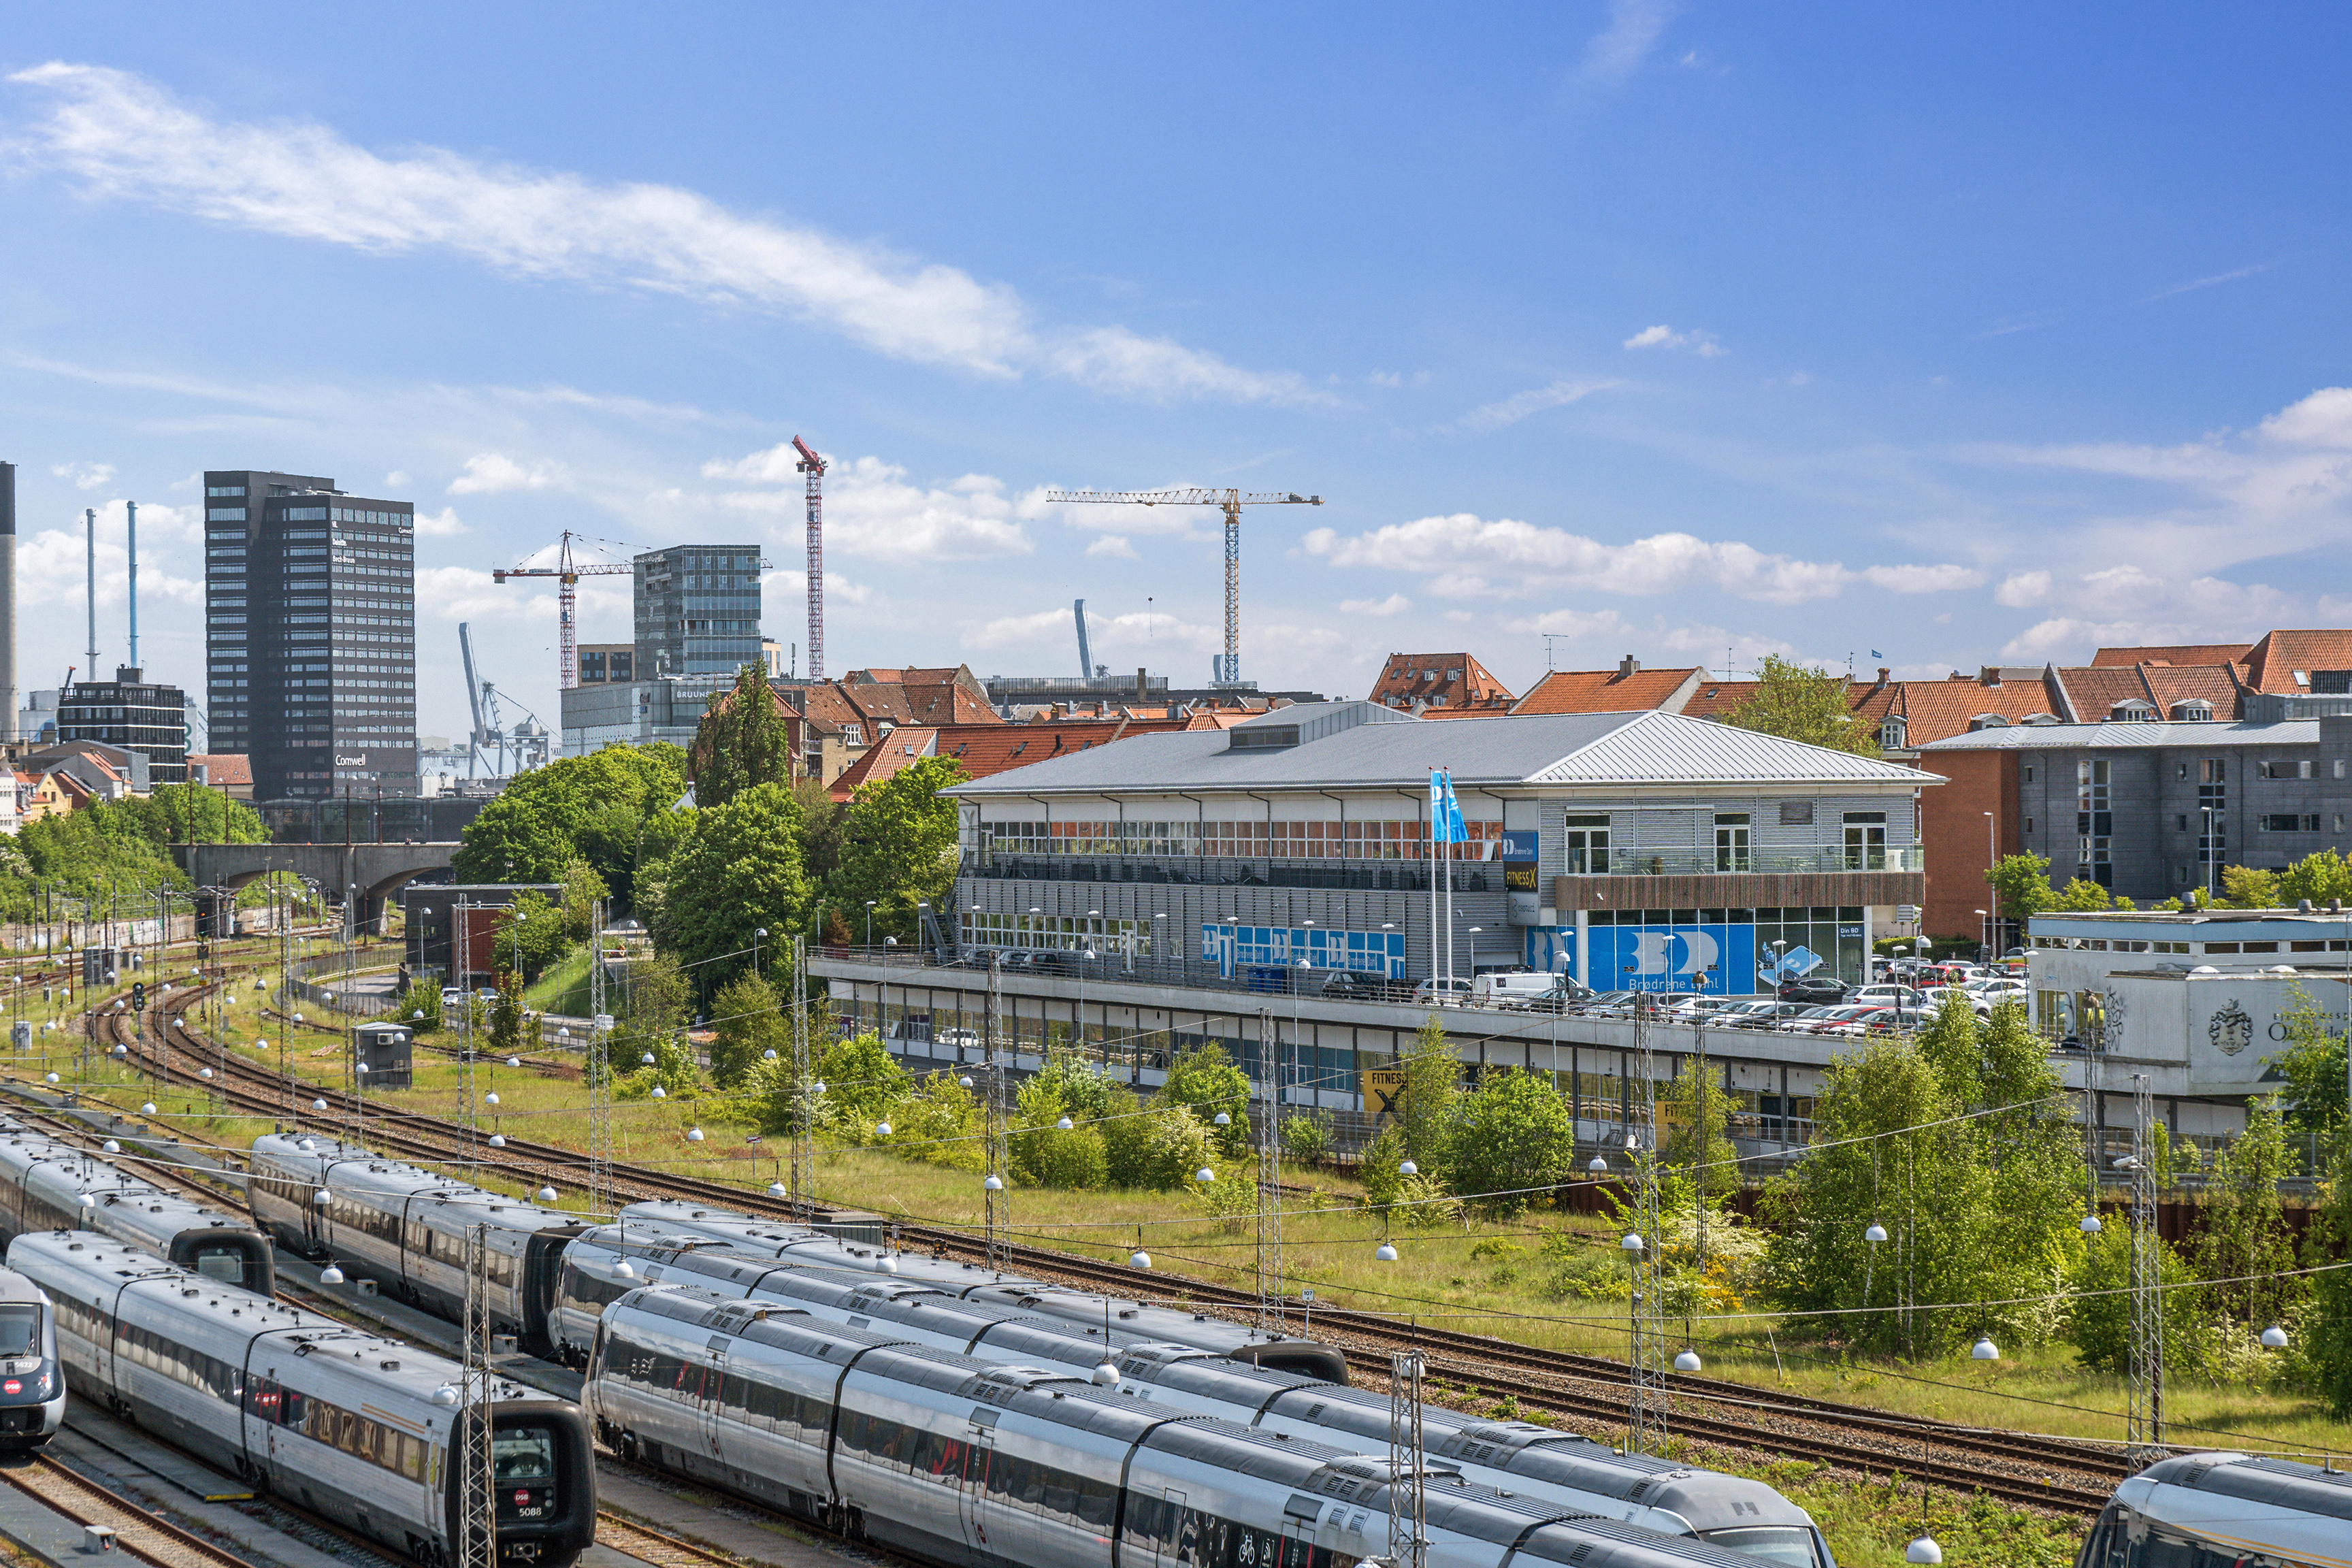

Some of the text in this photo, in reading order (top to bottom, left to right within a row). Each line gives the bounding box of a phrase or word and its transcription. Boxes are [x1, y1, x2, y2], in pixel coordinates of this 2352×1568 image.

[336, 753, 365, 766] Comwell
[1629, 979, 1686, 990] Brødrene
[519, 1507, 542, 1517] 5088
